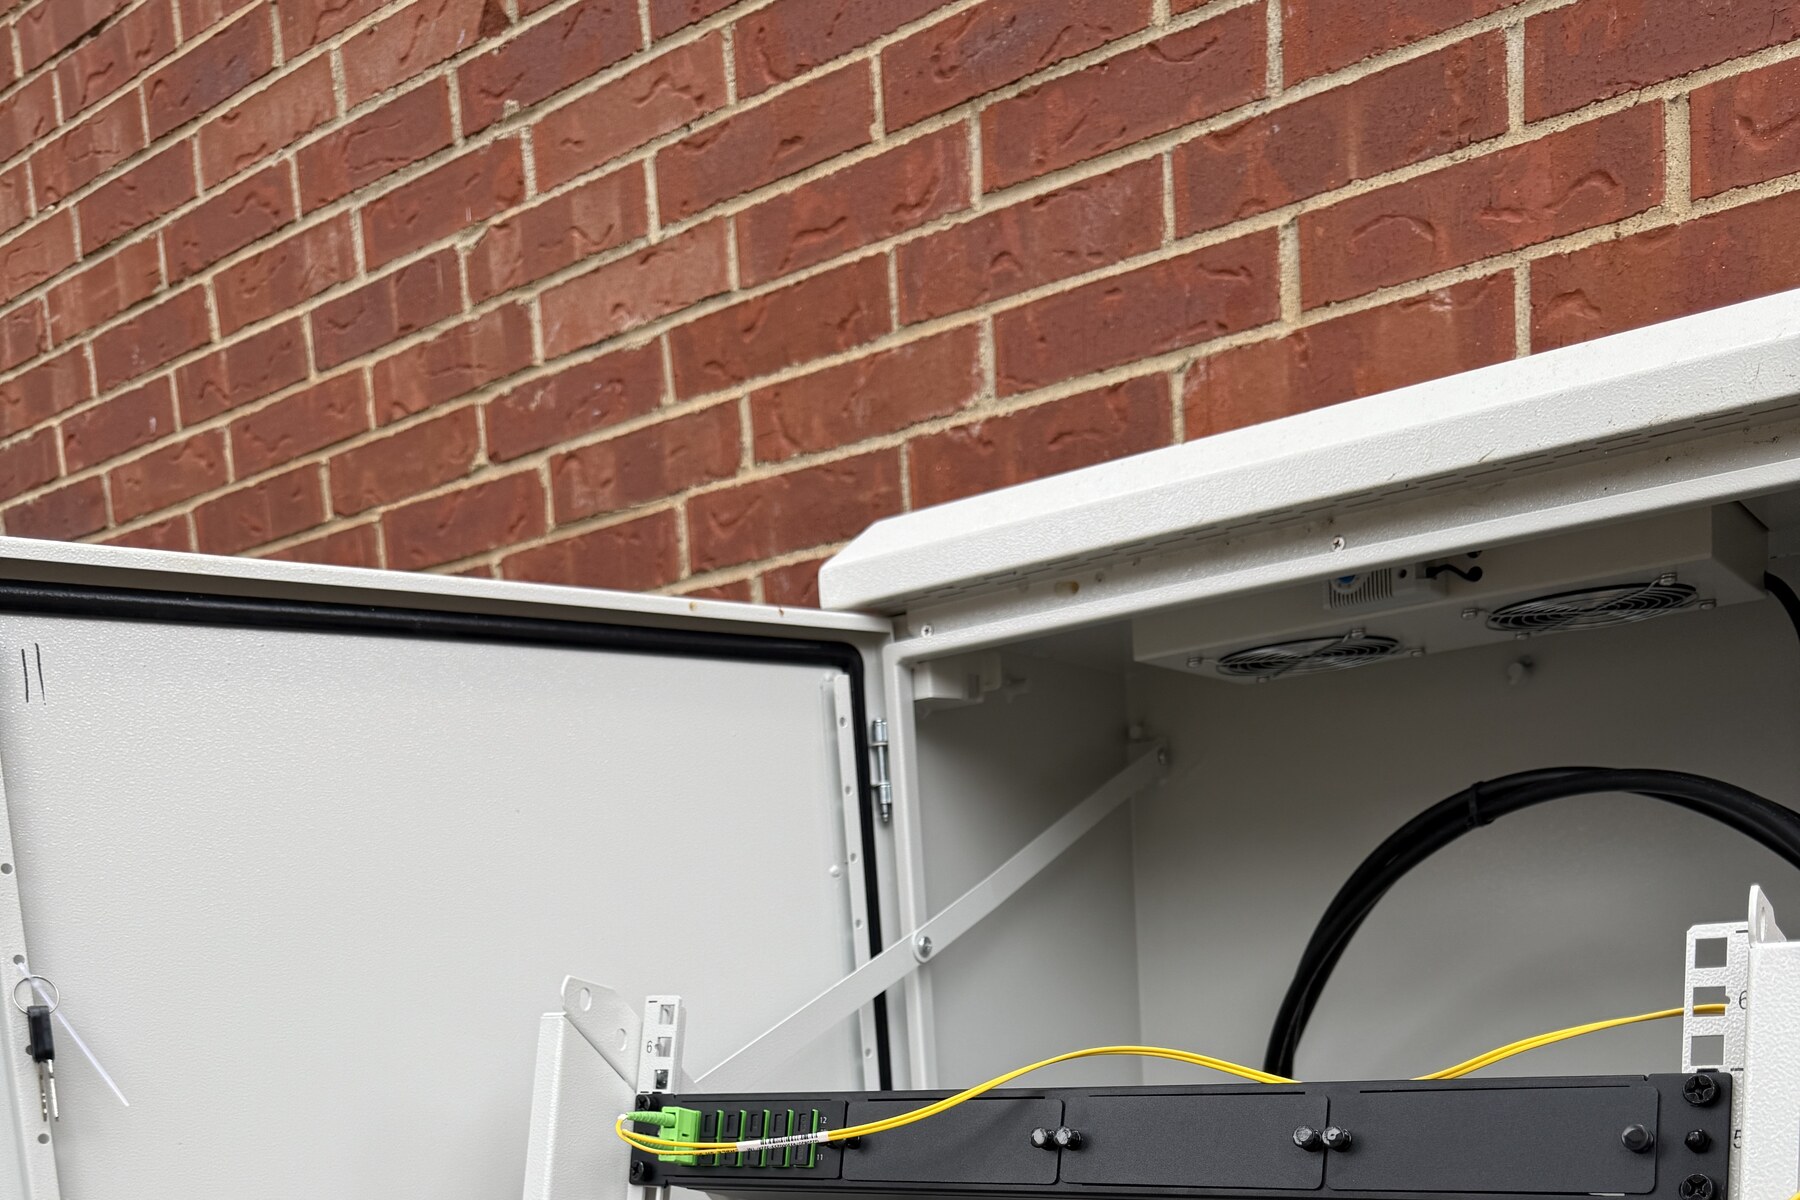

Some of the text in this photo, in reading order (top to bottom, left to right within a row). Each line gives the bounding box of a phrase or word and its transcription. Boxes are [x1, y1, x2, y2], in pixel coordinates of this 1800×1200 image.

[646, 1040, 653, 1054] 6
[820, 1116, 828, 1124] 12
[816, 1153, 824, 1161] 11
